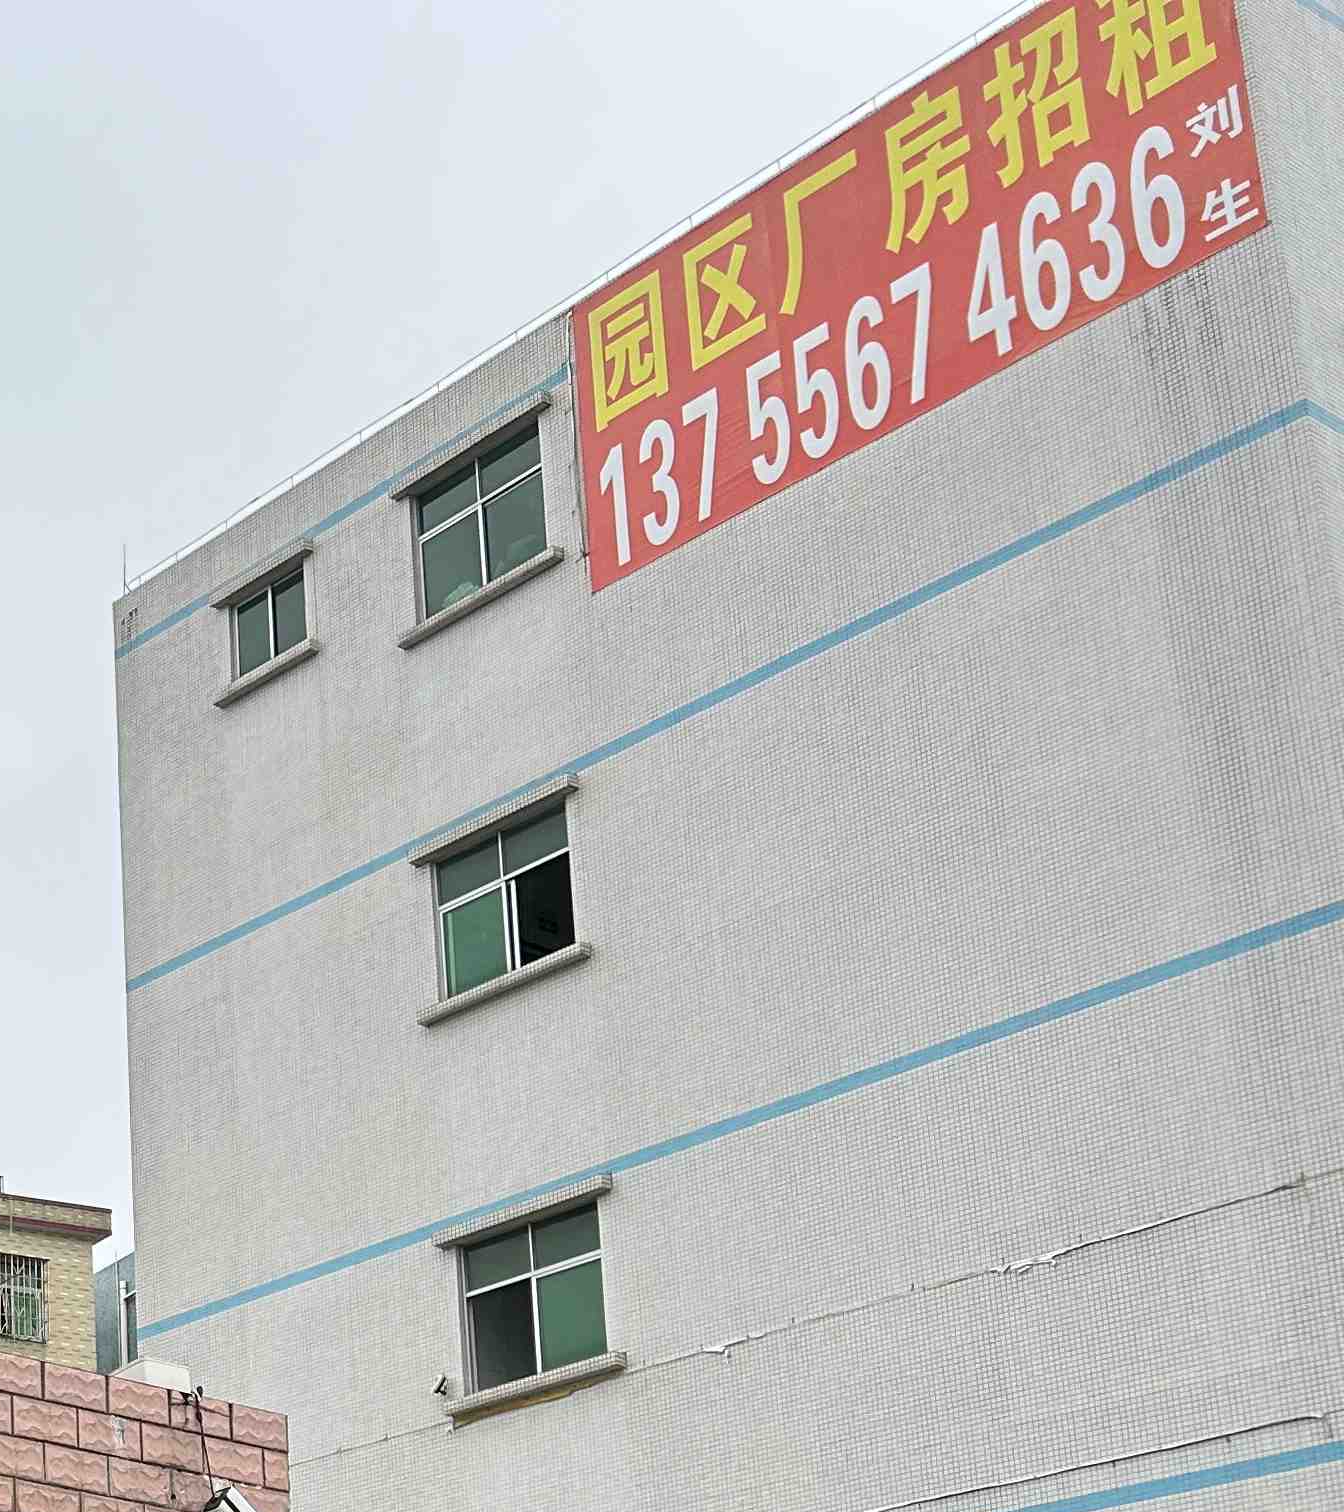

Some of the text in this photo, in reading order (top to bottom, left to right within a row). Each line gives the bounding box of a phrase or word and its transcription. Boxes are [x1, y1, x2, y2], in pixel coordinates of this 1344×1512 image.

[587, 0, 1218, 432] 园区厂房招租
[598, 125, 1187, 568] 137 5567 4636
[1185, 84, 1260, 244] 刘生
